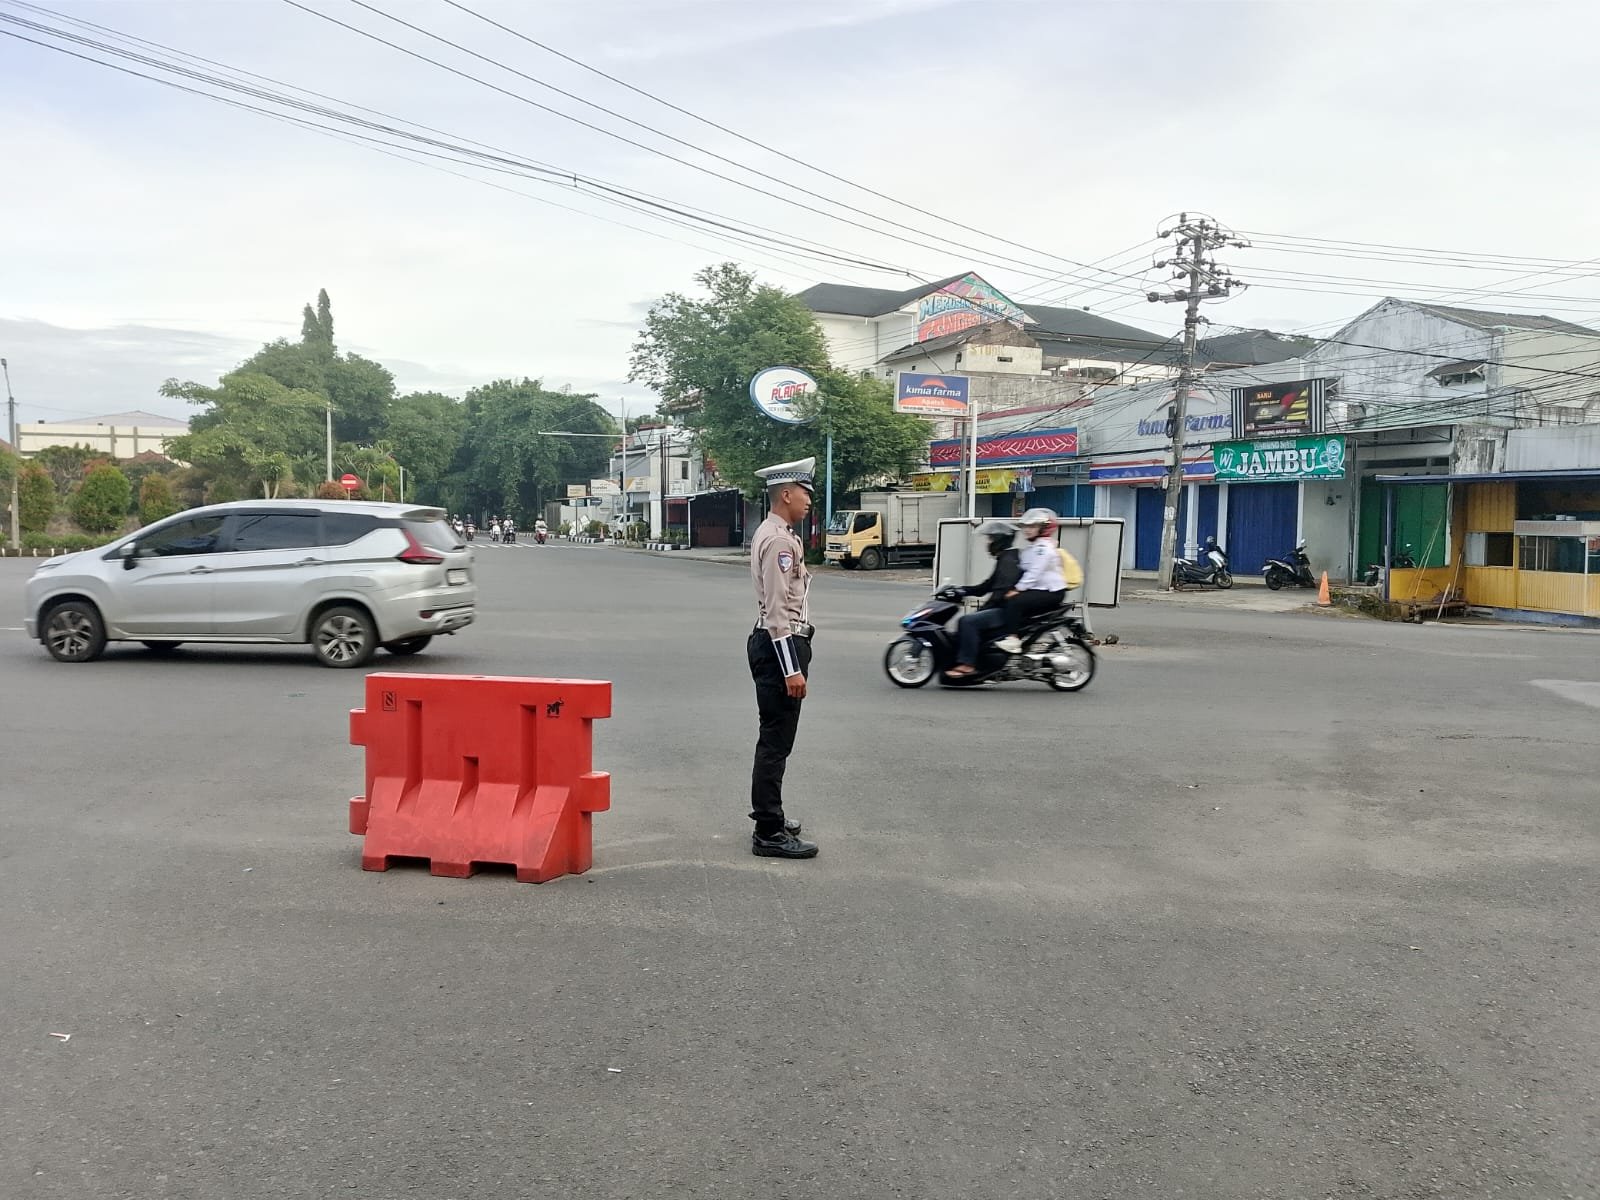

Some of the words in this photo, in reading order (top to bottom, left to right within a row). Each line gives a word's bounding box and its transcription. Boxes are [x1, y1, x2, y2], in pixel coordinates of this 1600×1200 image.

[771, 383, 808, 400] PLANET
[906, 385, 932, 395] kimia
[933, 387, 961, 396] farma
[1236, 448, 1316, 475] JAMBU
